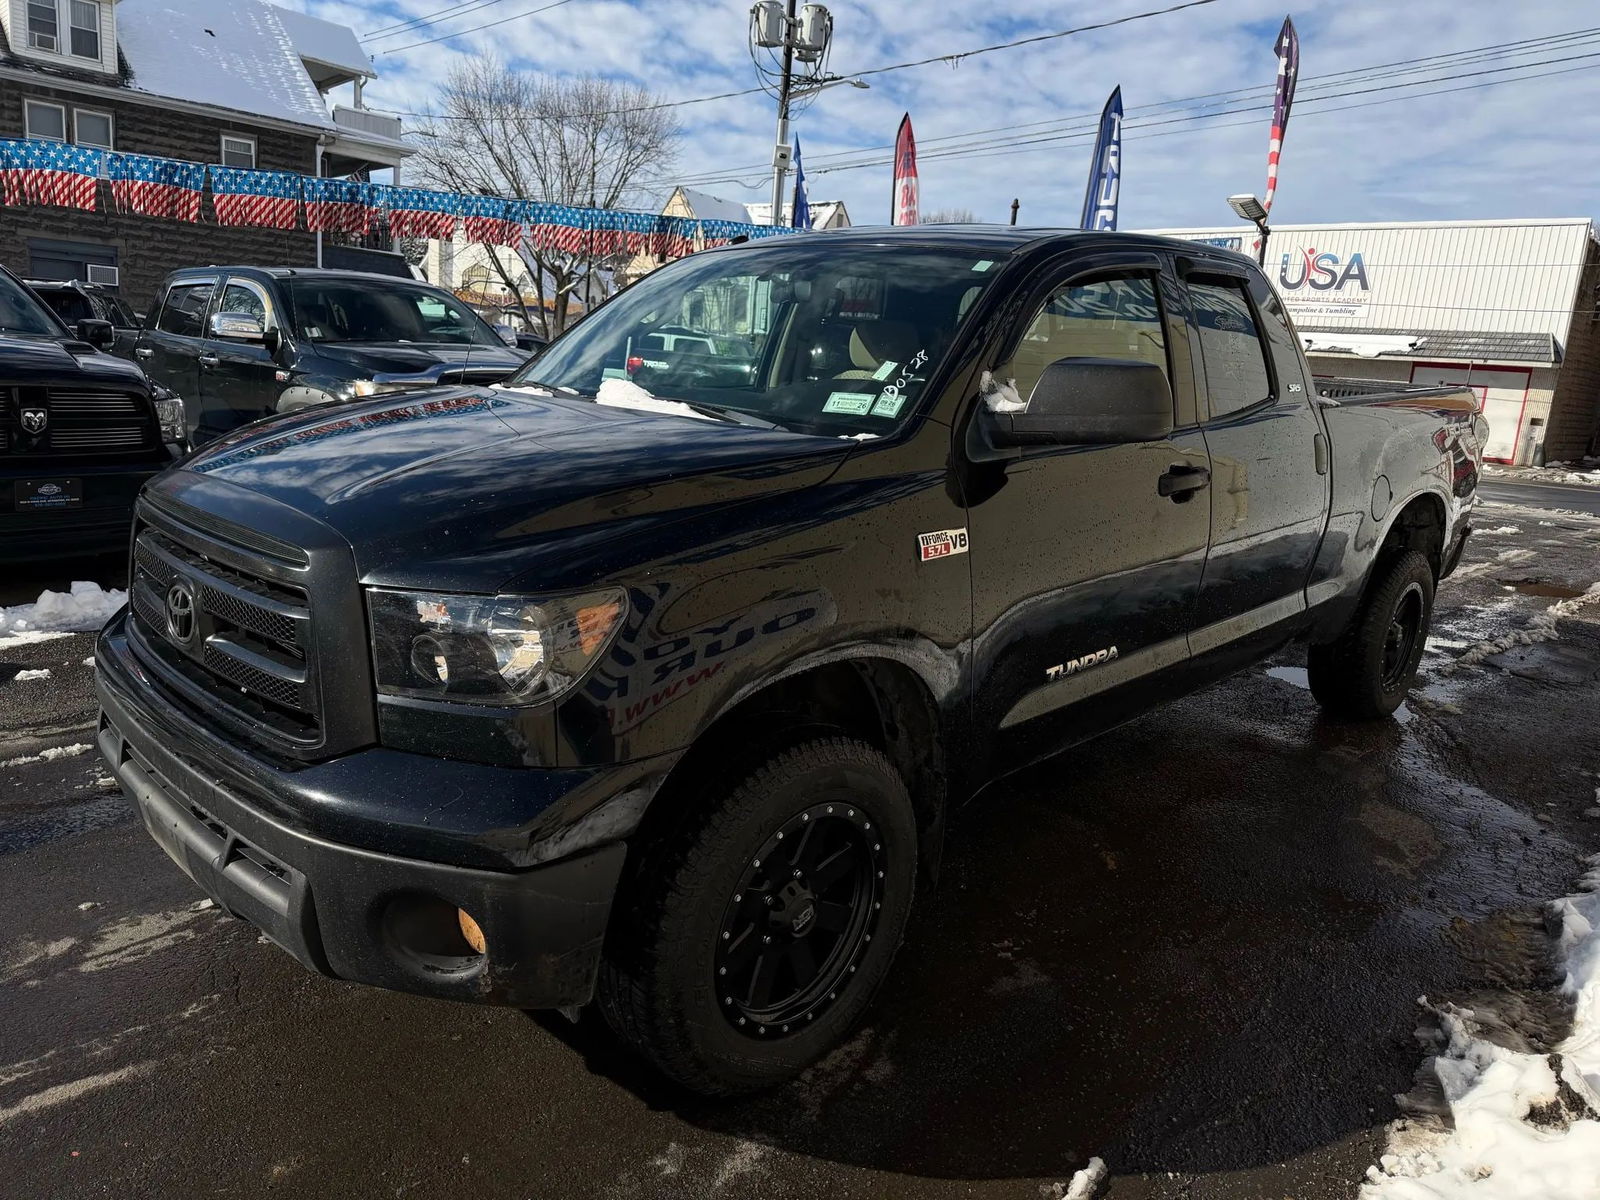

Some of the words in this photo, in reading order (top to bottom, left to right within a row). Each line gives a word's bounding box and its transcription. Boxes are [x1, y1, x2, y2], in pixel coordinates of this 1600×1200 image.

[1280, 250, 1369, 291] USA
[1332, 296, 1368, 304] ACADEMY
[1286, 306, 1318, 316] ampoline
[1325, 308, 1357, 316] Tumbling
[950, 533, 967, 549] V8
[928, 544, 948, 557] 5.7L
[1046, 645, 1119, 681] TUNDRA
